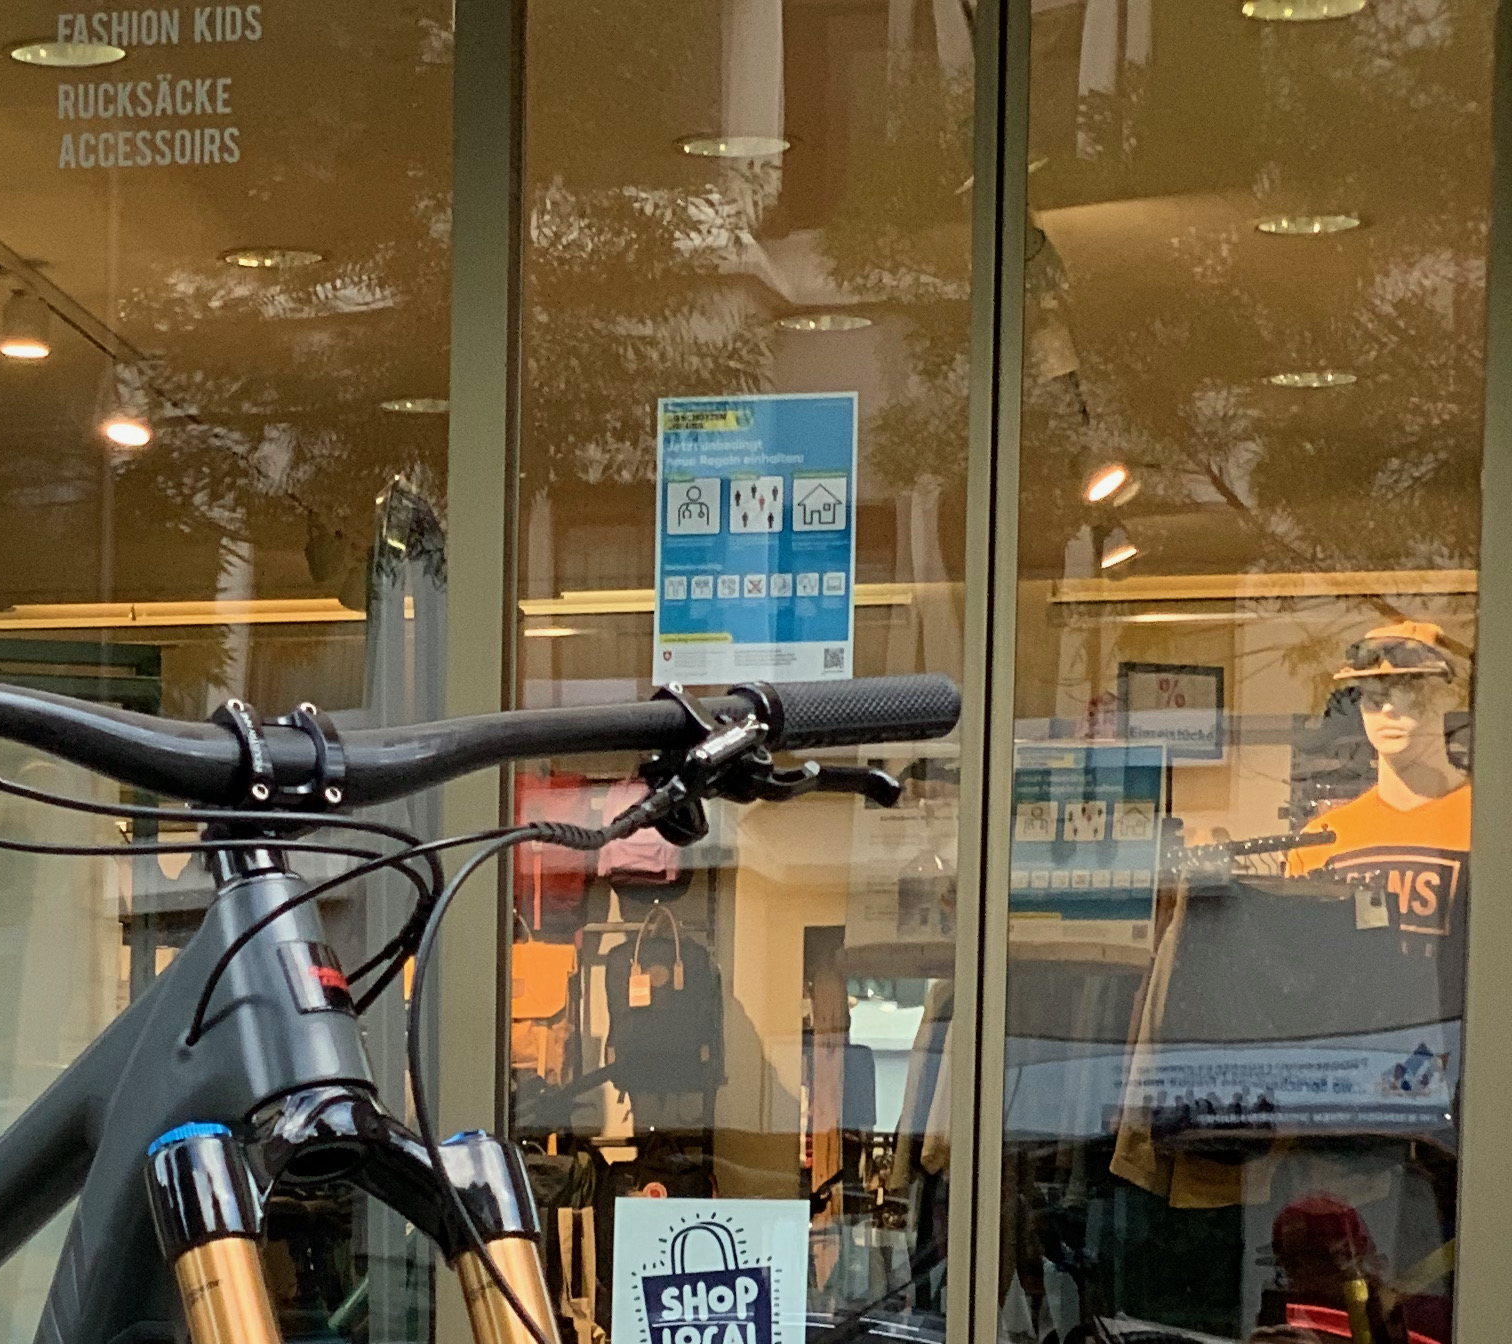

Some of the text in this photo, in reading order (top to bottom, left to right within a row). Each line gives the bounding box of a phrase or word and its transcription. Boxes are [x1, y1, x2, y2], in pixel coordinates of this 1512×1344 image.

[57, 5, 263, 46] FASHION KIDS
[57, 74, 233, 120] RUCKSÄCKE
[59, 128, 241, 169] ACCESSOIRS
[660, 1275, 759, 1322] SHOP
